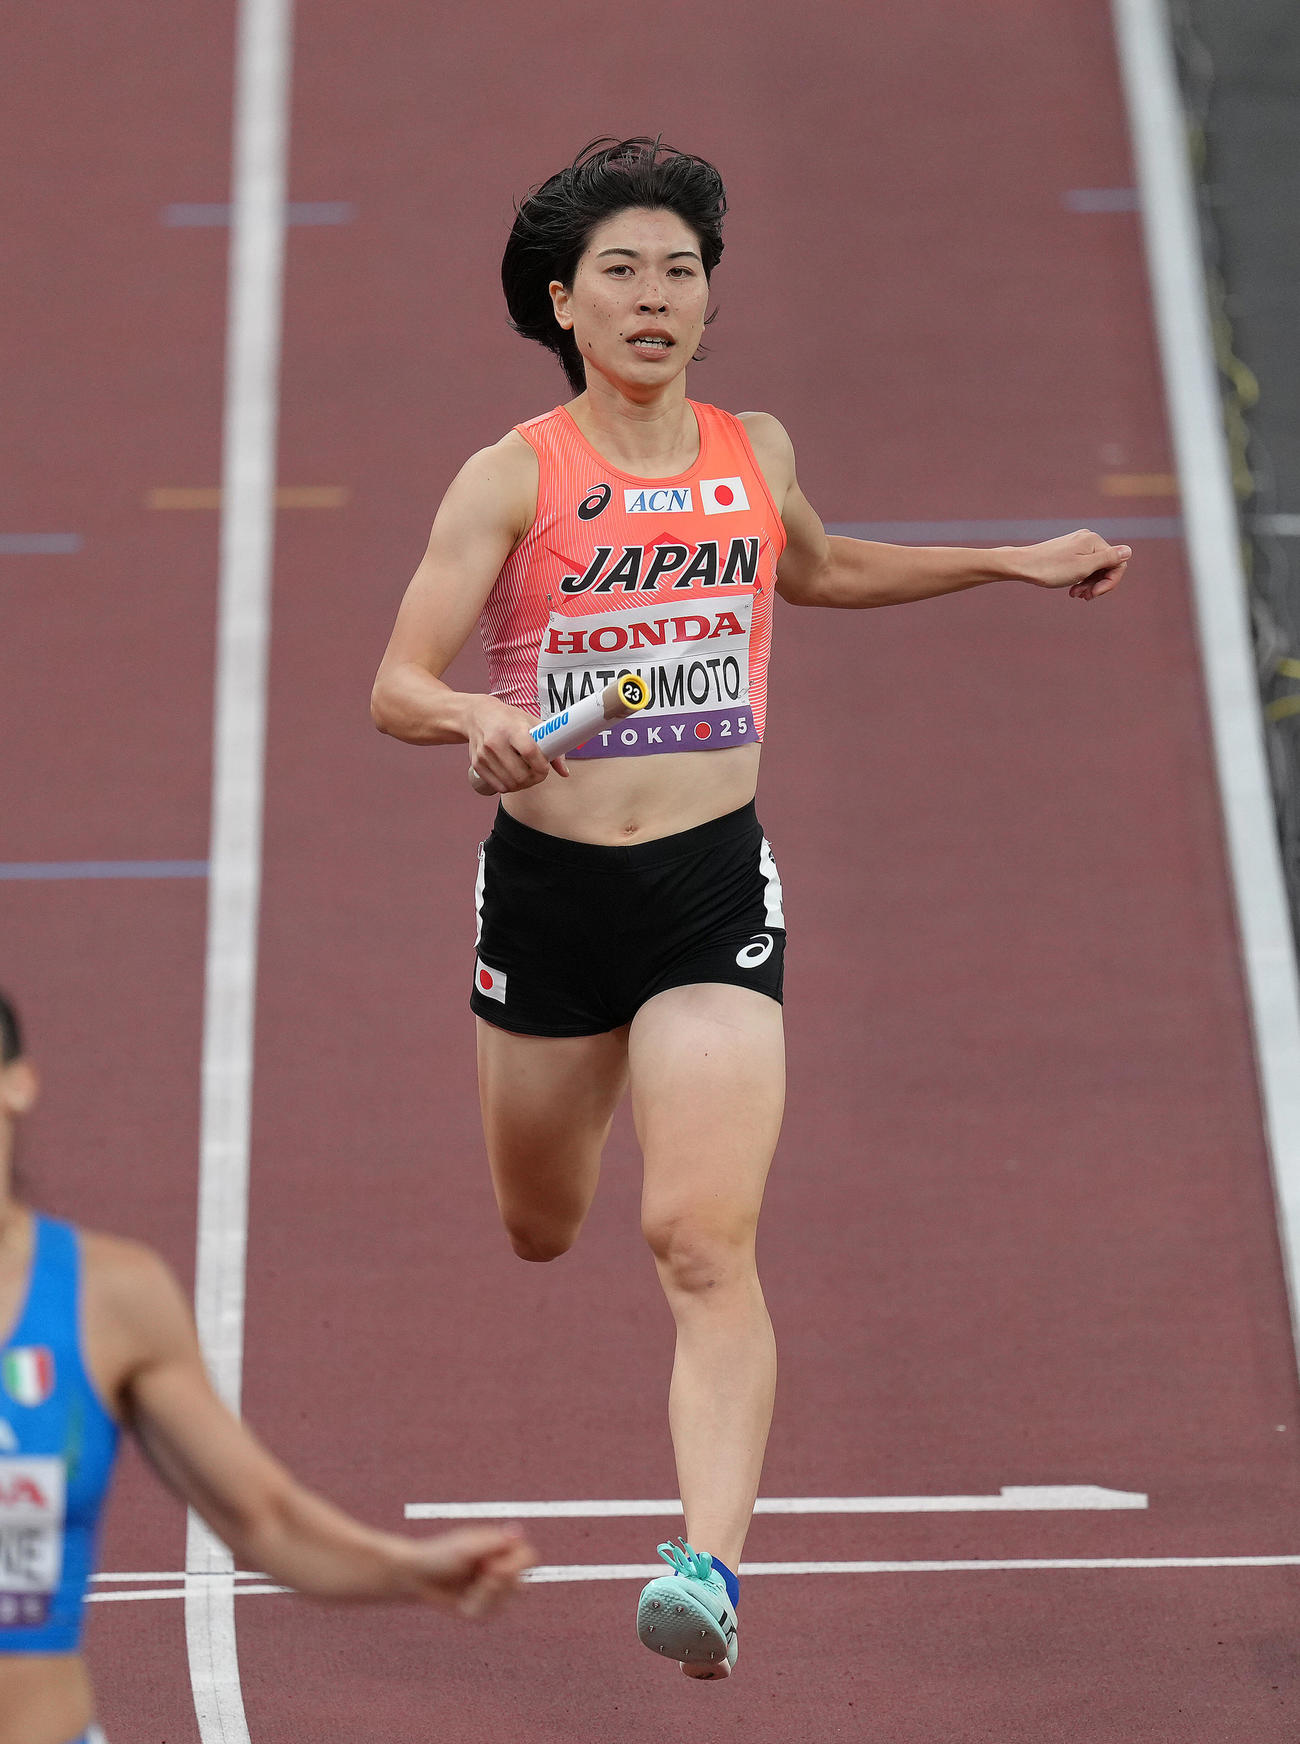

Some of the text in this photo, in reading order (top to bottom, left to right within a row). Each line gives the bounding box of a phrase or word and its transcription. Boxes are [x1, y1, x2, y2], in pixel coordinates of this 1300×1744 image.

[628, 488, 690, 512] ACN
[560, 537, 759, 595] JAPAN
[544, 611, 746, 654] HONDA
[547, 656, 741, 713] MATUMOTO
[624, 684, 640, 702] 23
[720, 717, 748, 737] 25
